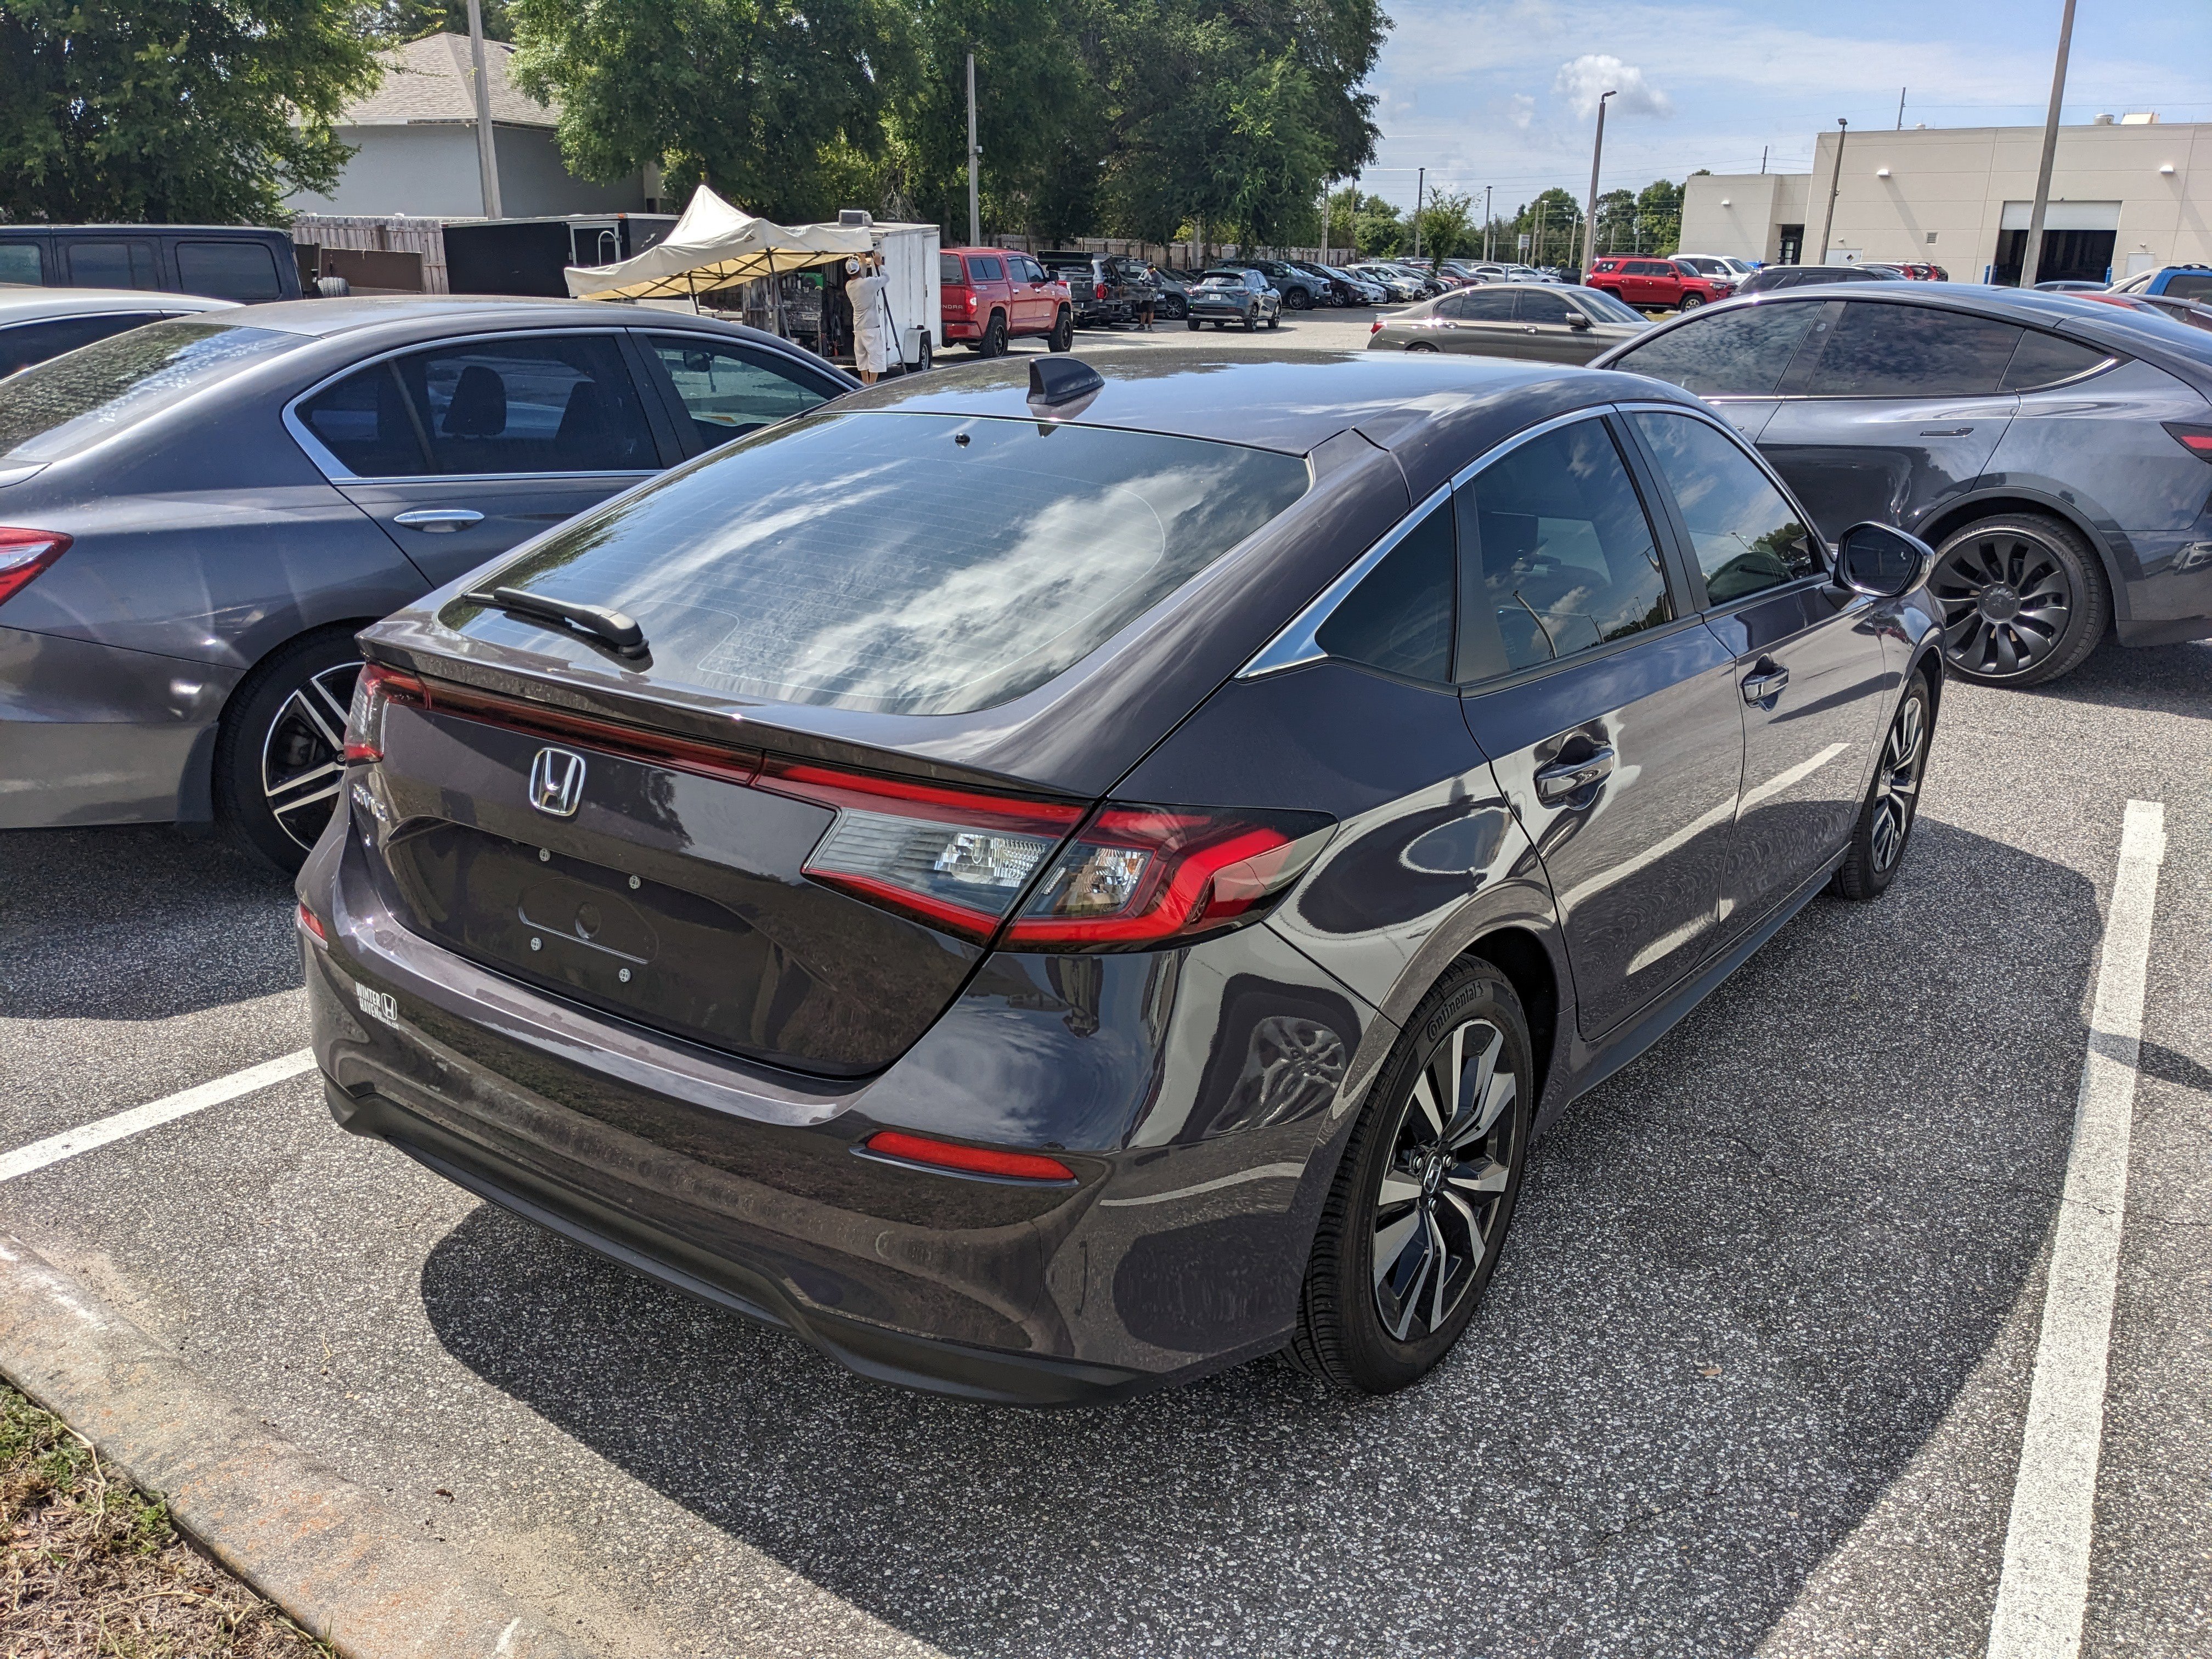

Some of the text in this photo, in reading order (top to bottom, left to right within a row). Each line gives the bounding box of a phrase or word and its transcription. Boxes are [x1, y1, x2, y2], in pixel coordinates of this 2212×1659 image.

[355, 981, 381, 1007] WINTER
[359, 996, 379, 1019] HAVEN
[1427, 982, 1477, 1042] Continental
